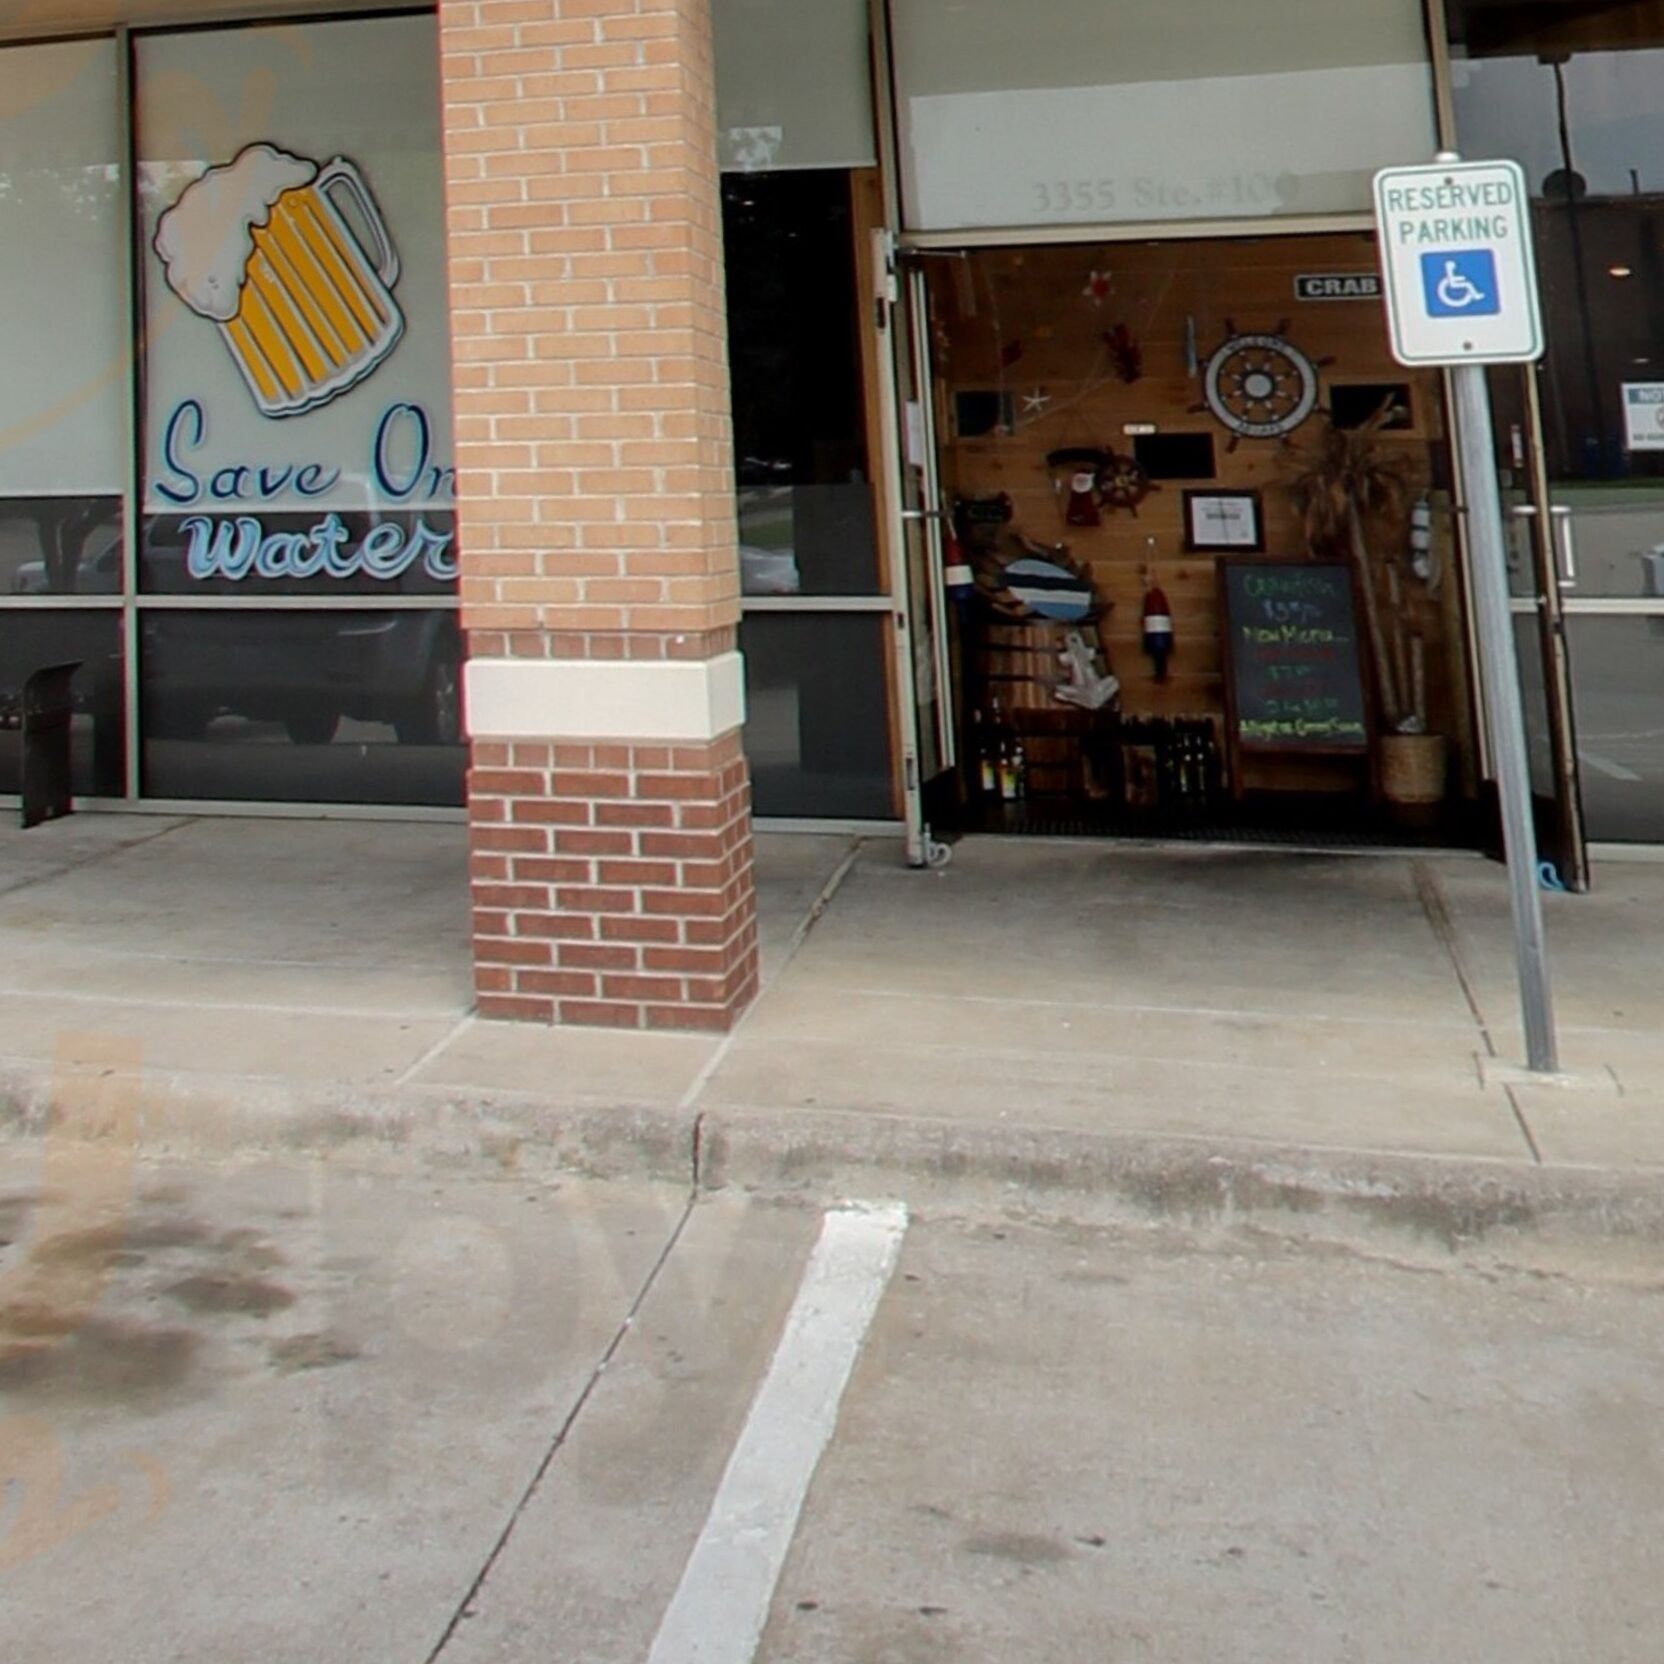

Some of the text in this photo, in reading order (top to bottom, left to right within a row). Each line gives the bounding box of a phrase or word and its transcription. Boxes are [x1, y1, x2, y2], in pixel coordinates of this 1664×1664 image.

[1387, 181, 1513, 213] RESERVED
[1399, 215, 1509, 245] PARKING
[1305, 278, 1378, 295] CRAB
[156, 399, 342, 503] Save
[178, 513, 461, 580] Water
